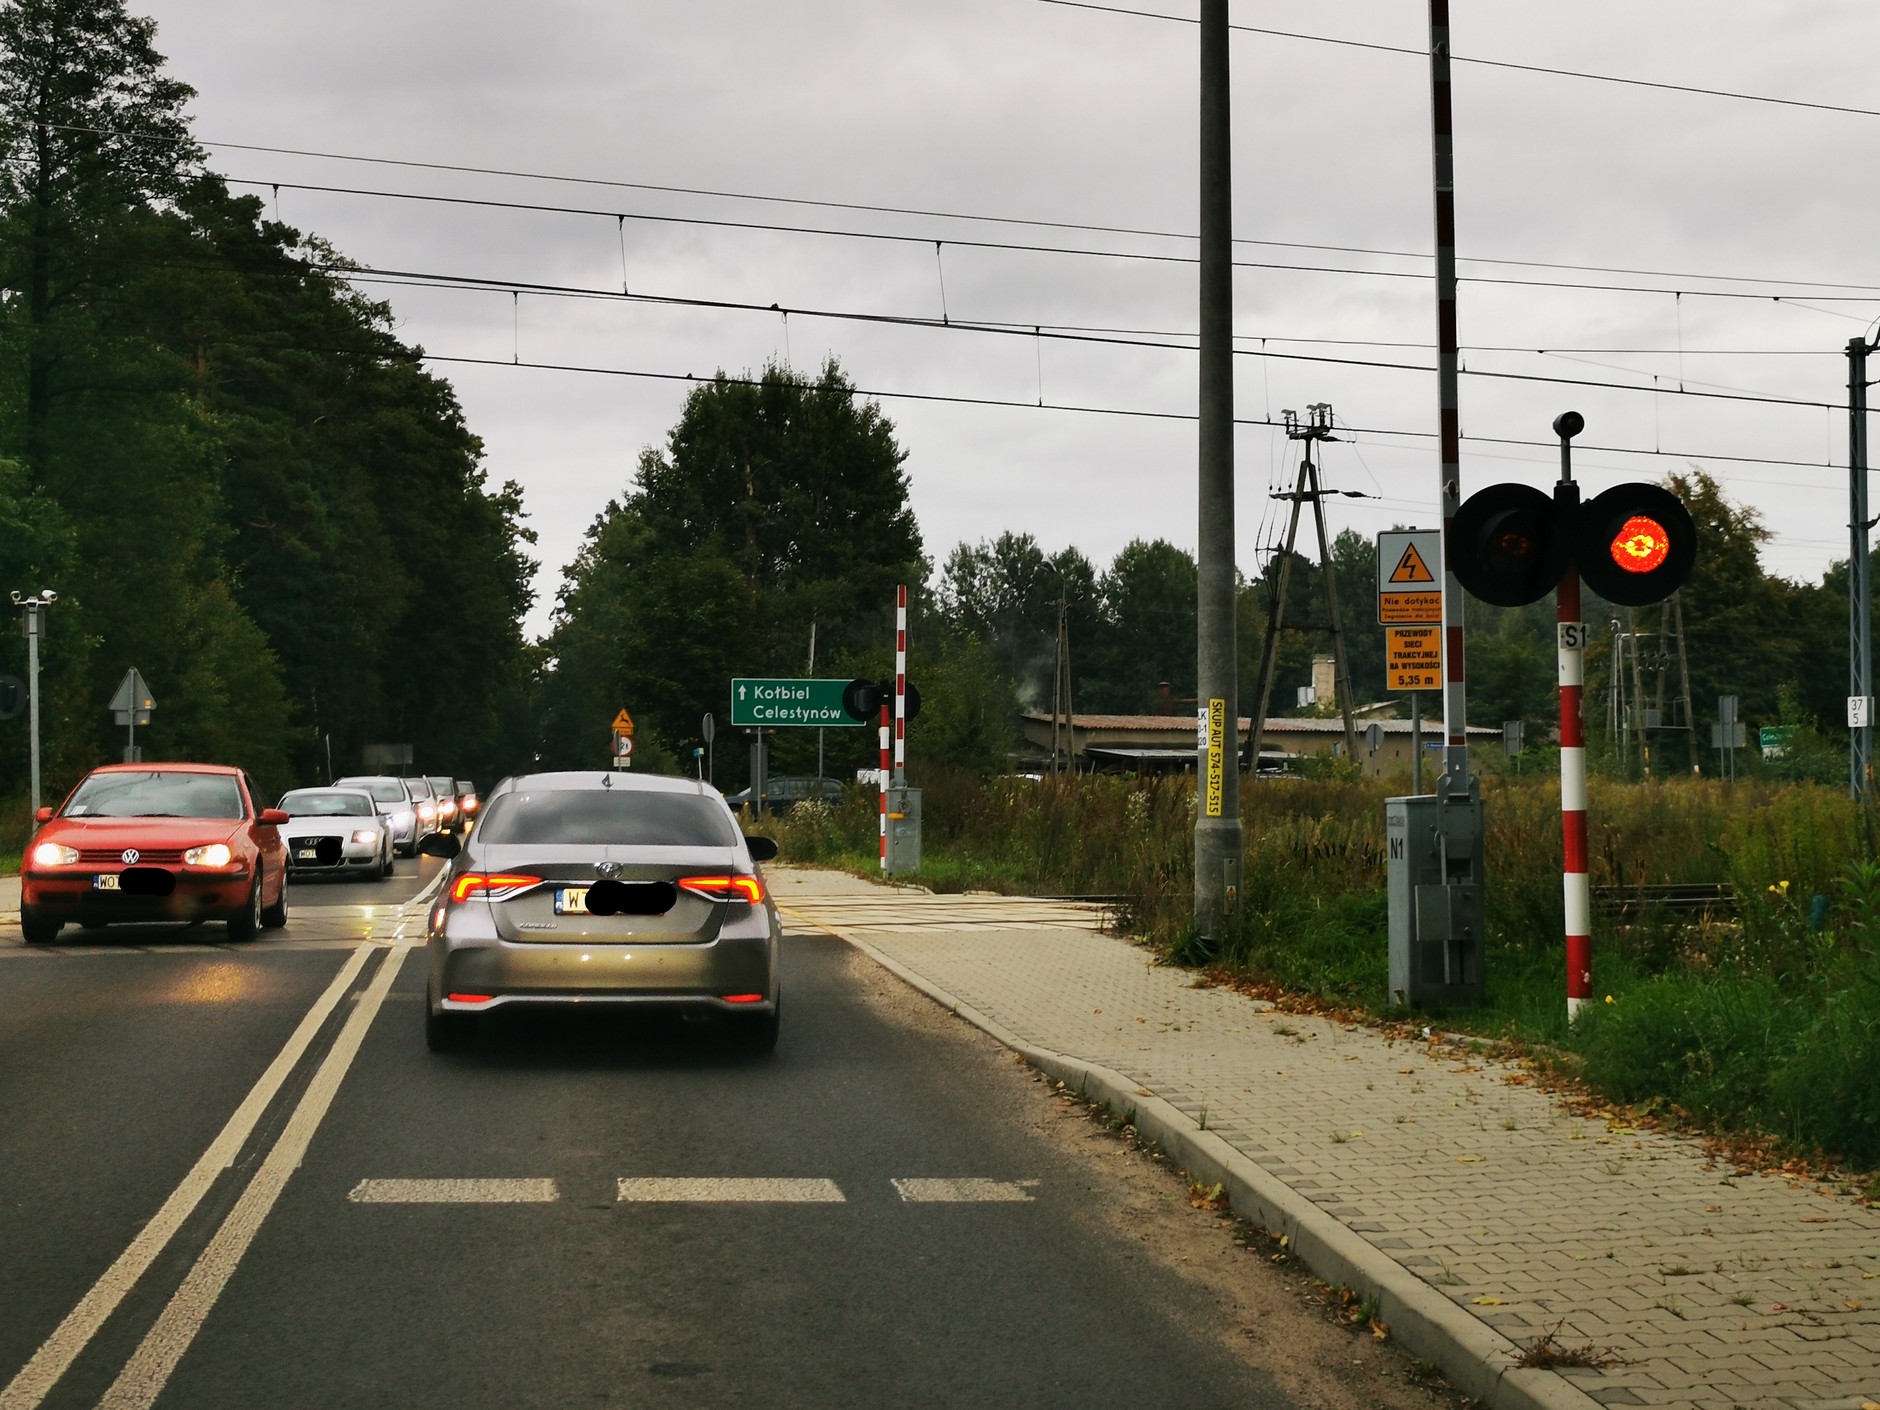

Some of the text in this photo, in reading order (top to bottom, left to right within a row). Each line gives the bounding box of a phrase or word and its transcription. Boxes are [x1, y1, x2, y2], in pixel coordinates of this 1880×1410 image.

[1384, 597, 1400, 605] Nie
[1565, 625, 1586, 647] S1
[1404, 640, 1422, 648] SIECI
[1394, 651, 1438, 659] TRAKCYJNEJ
[1401, 660, 1440, 669] WYSOKOŚCI
[1398, 675, 1434, 686] 5,35 m
[754, 686, 810, 700] Kołbiel
[1851, 699, 1863, 711] 37
[753, 705, 841, 722] Celestynów
[1853, 713, 1859, 725] 5
[1208, 701, 1223, 813] SKUP AUT 574-517-515
[1391, 837, 1403, 860] N1
